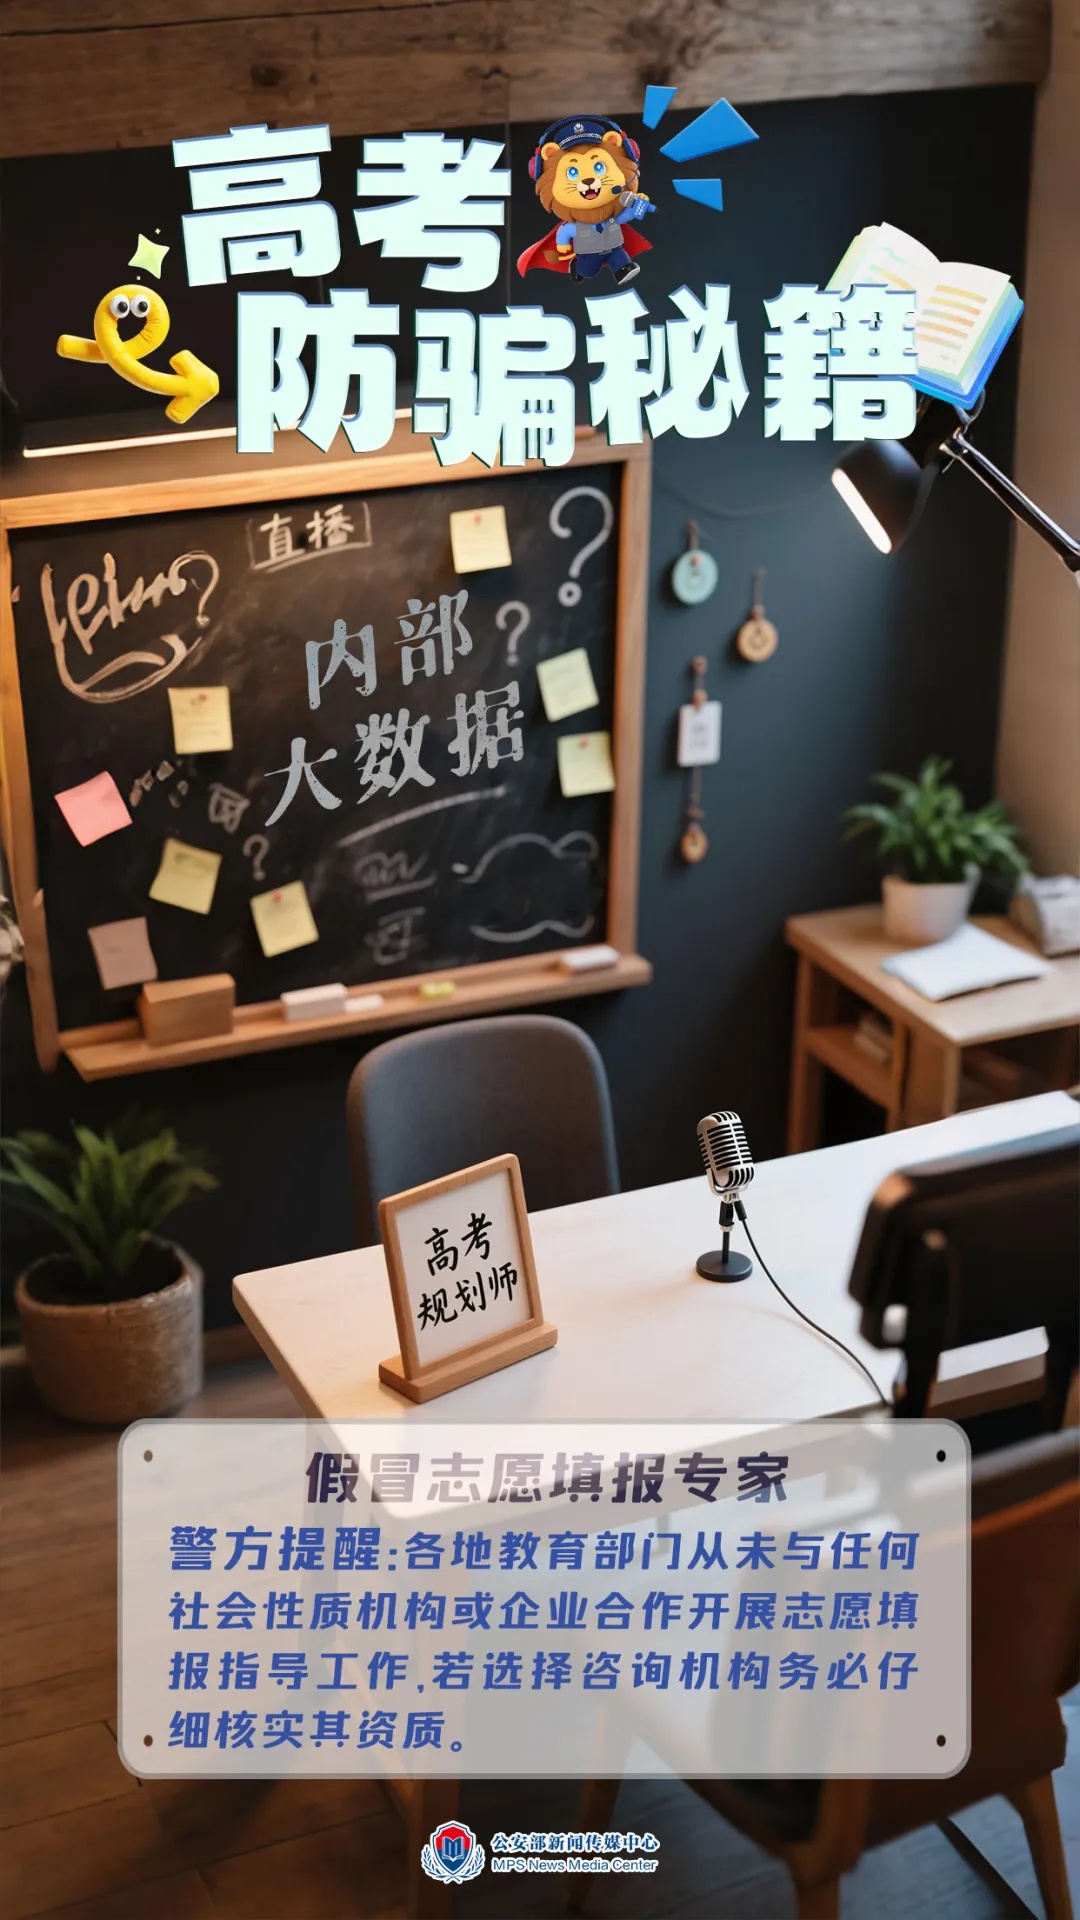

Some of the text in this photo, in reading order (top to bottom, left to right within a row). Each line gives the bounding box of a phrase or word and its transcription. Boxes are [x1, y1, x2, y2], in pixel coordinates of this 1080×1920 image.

[305, 589, 473, 710] 内部
[263, 681, 525, 827] 大数据
[424, 1212, 493, 1277] 高考
[416, 1261, 519, 1331] 规划师
